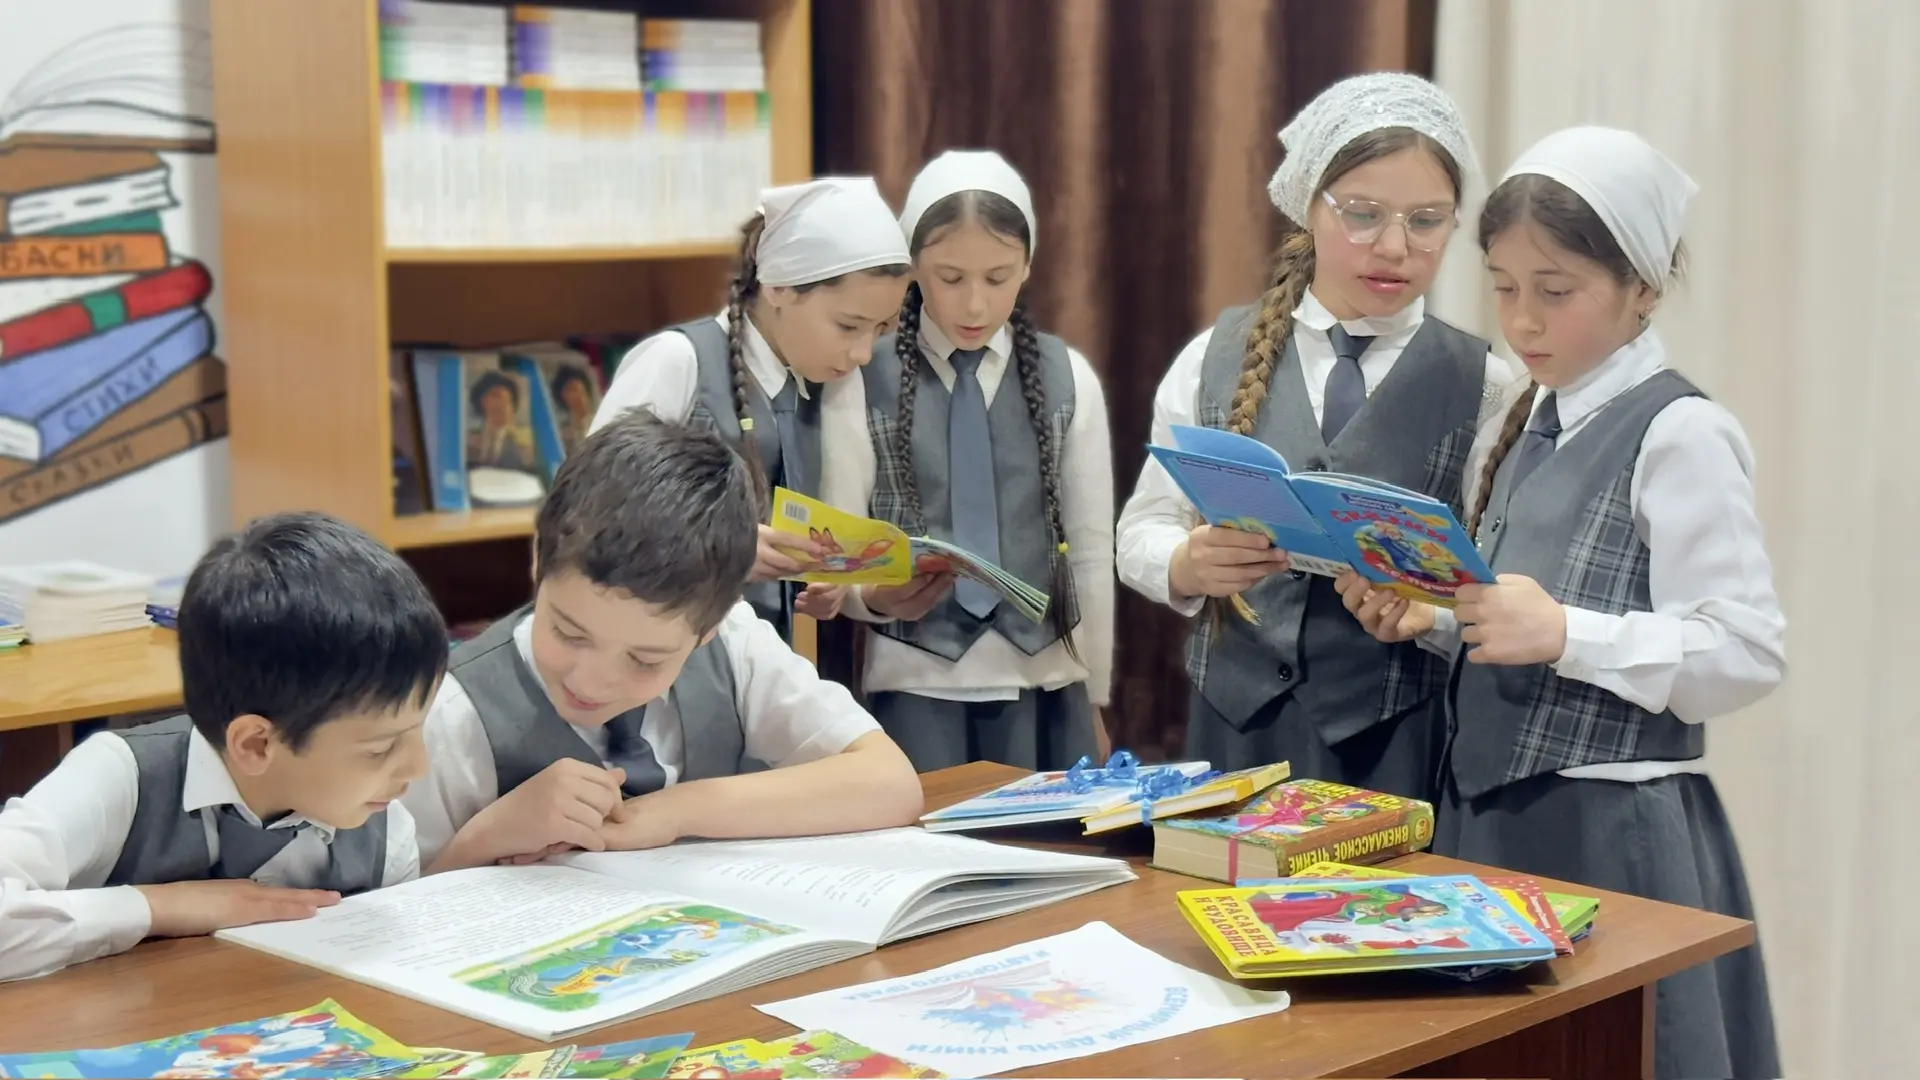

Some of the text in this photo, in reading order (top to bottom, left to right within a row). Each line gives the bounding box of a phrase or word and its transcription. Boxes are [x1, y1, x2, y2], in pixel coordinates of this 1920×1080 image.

[0, 242, 126, 273] БАСНИ
[62, 354, 159, 433] СТИХИ
[8, 443, 134, 504] СКАЗКИ
[1288, 847, 1331, 876] ЧТЕНИЕ
[1333, 824, 1409, 861] ВНЕКЛАССНОЕ
[1202, 905, 1258, 957] ЧУДОВИЩЕ
[1214, 895, 1279, 956] КРАСАВИЦА
[842, 982, 908, 1001] ПРАВА
[912, 953, 1033, 988] АВТОРСКОГО
[905, 986, 1189, 1056] ВСЕМИРНЫЙ ДЕНЬ КНИГИ
